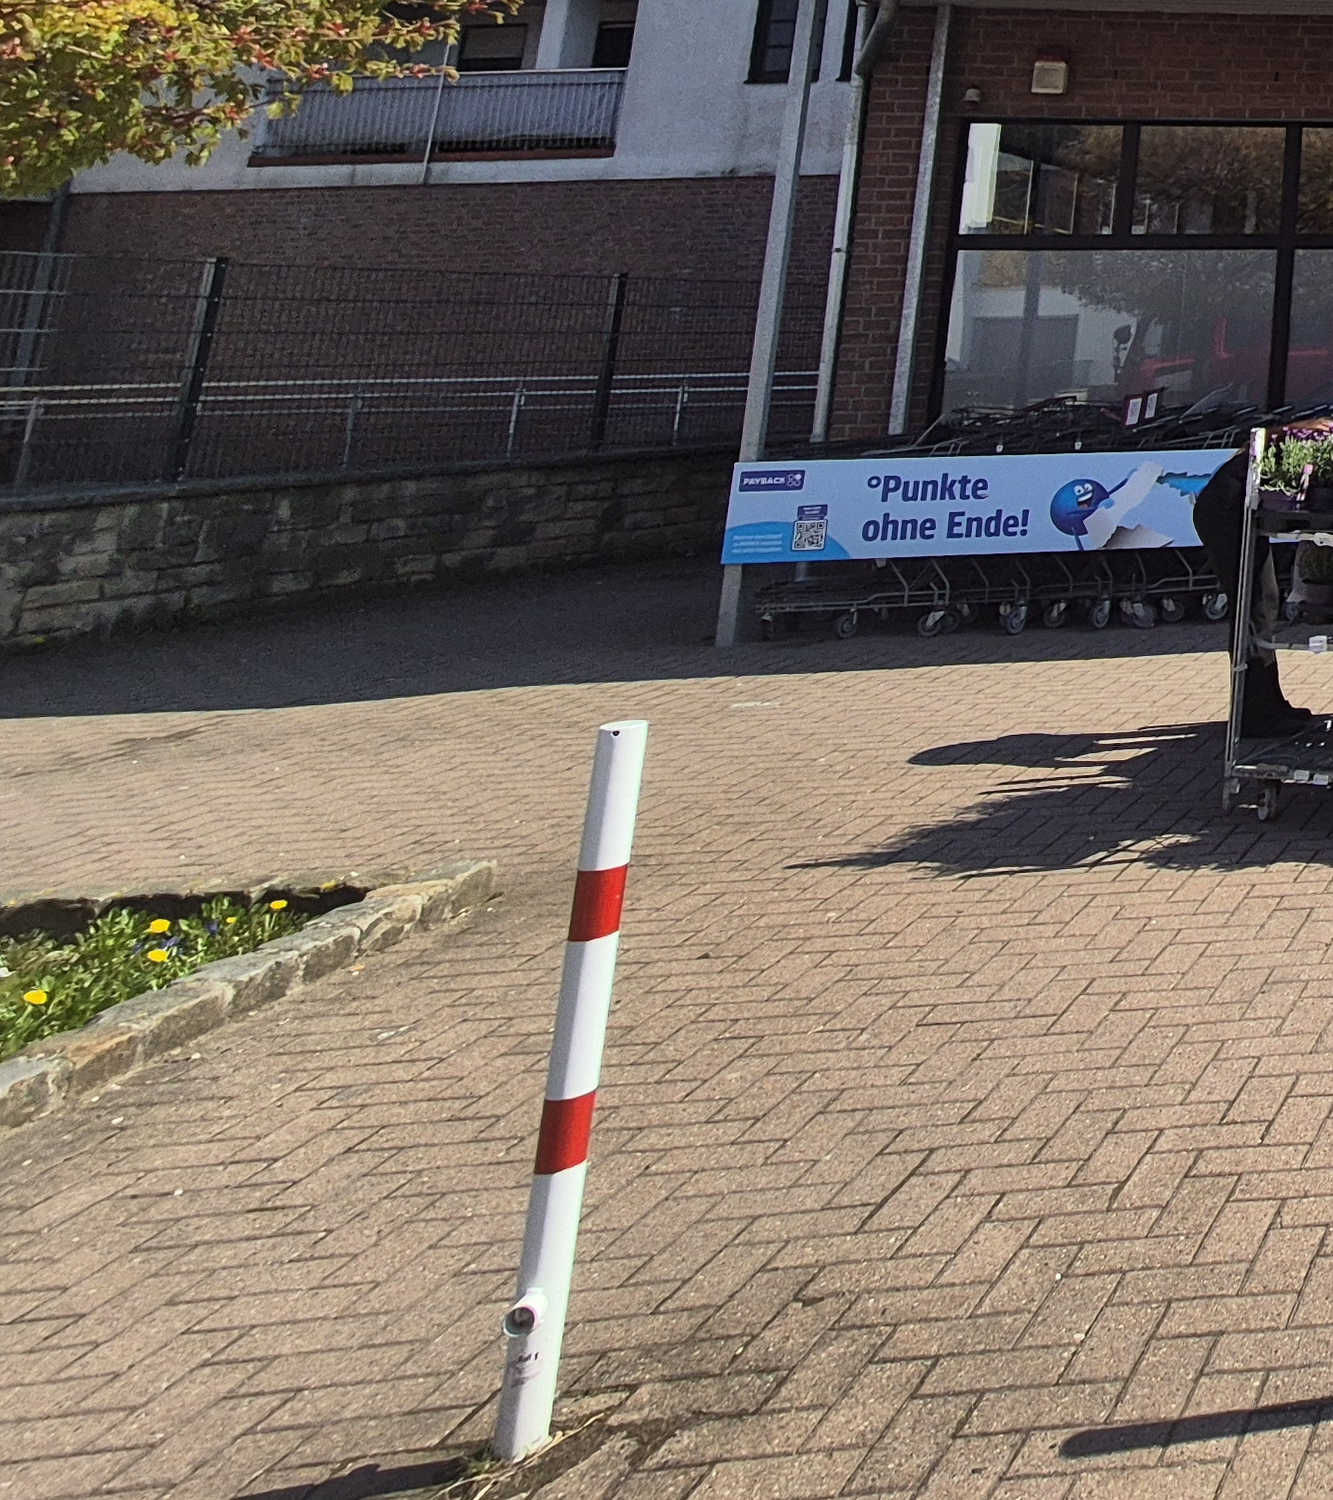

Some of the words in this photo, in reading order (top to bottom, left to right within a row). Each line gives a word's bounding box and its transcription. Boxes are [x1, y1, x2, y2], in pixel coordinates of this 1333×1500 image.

[743, 477, 785, 485] PAYBACK
[861, 512, 937, 542] ohne
[946, 509, 1030, 538] Ende!
